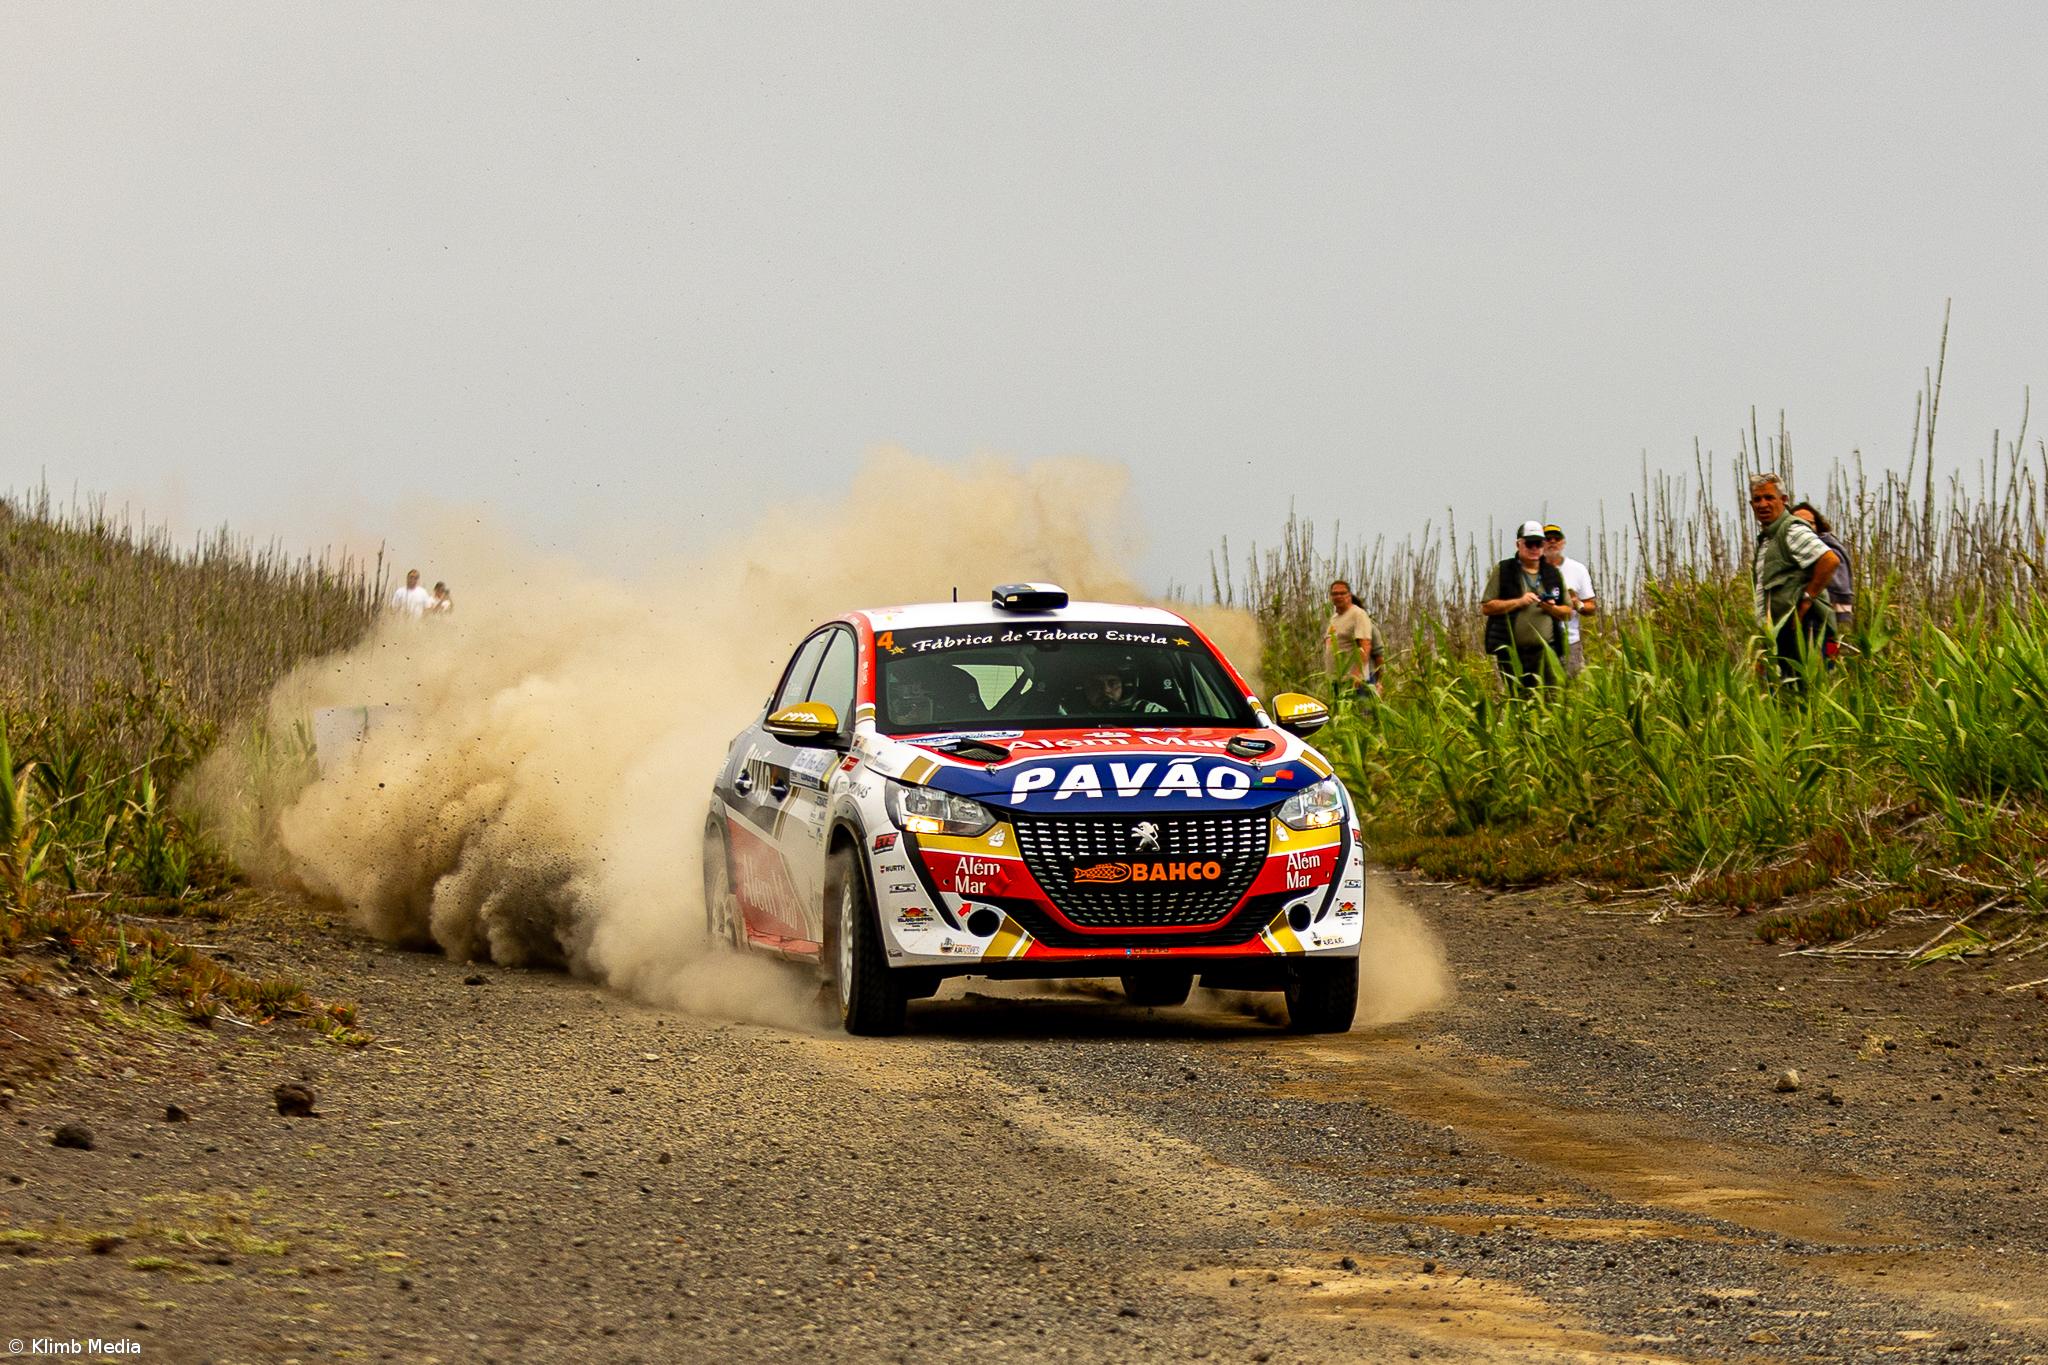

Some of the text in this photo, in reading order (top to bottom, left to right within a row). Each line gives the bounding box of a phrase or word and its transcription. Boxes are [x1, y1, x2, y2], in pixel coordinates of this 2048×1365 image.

[877, 631, 894, 650] 4
[912, 629, 1168, 652] Fábrica de Tabaco Estrela
[1010, 756, 1251, 805] PAVÃO
[955, 856, 1001, 876] Além
[1132, 861, 1221, 881] BAHCO
[1286, 851, 1321, 871] Além
[955, 875, 987, 894] Mar
[1286, 871, 1313, 889] Mar
